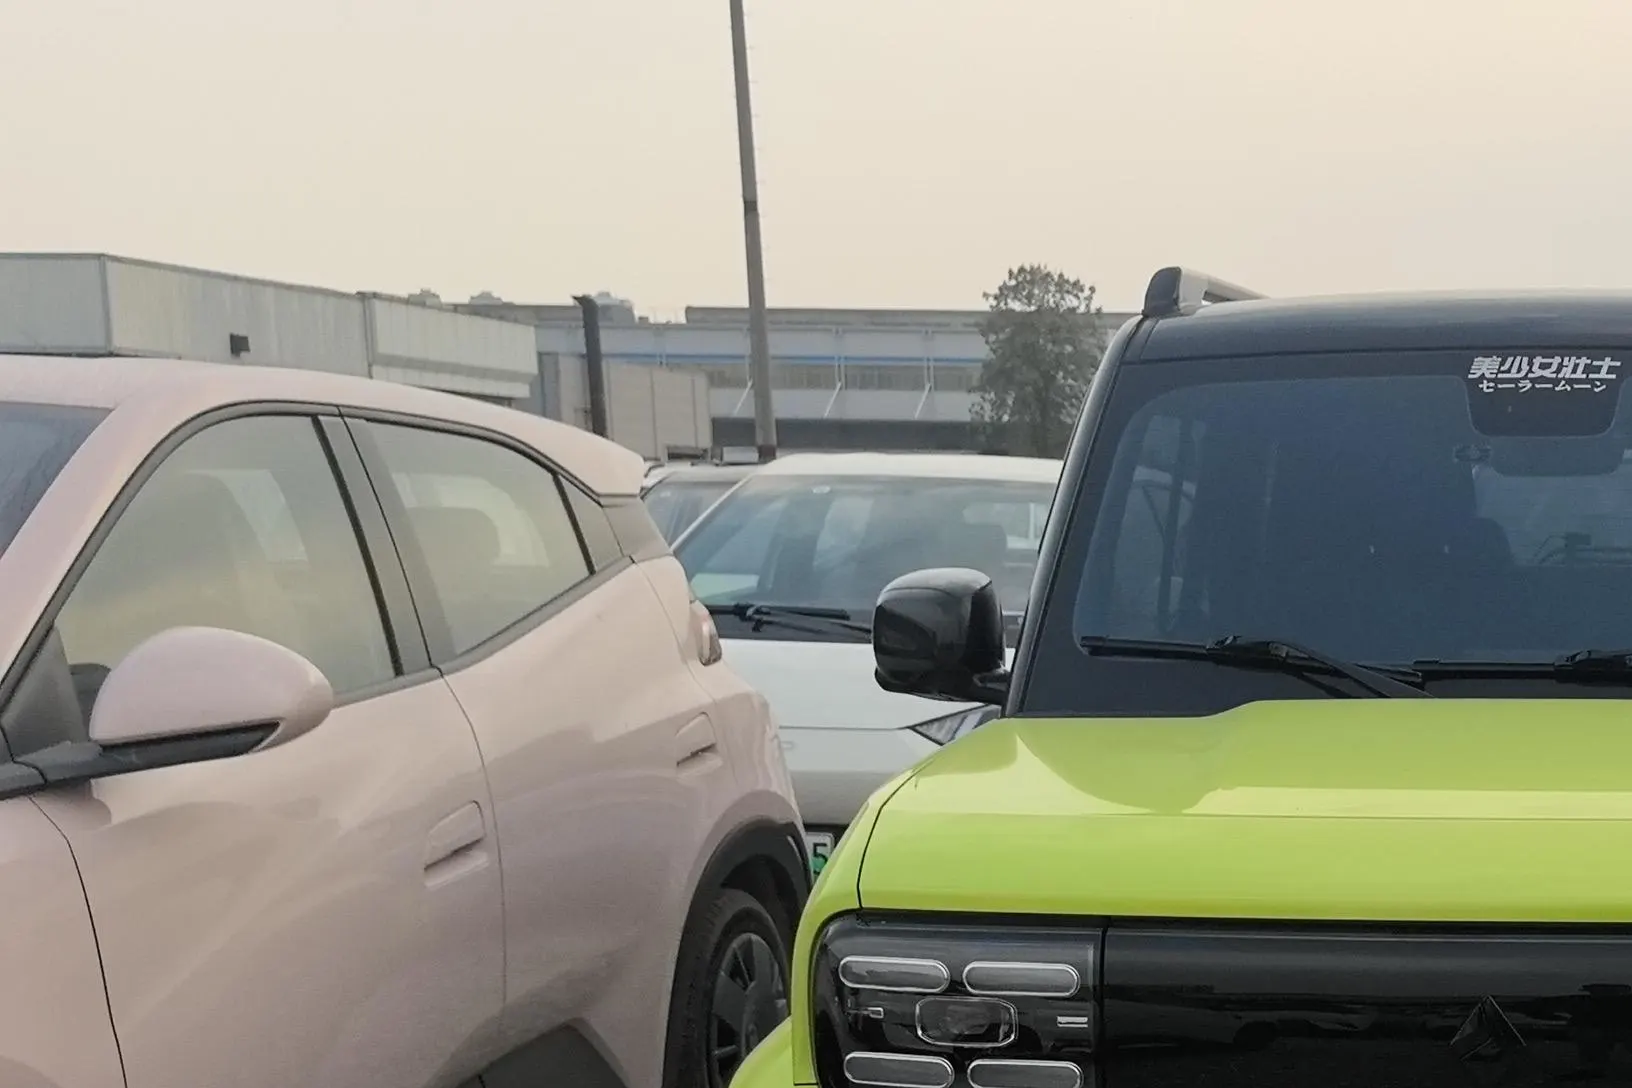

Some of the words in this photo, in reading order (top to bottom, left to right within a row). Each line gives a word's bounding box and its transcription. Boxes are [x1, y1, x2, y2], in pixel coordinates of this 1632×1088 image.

[1479, 380, 1606, 392] セーラームーン
